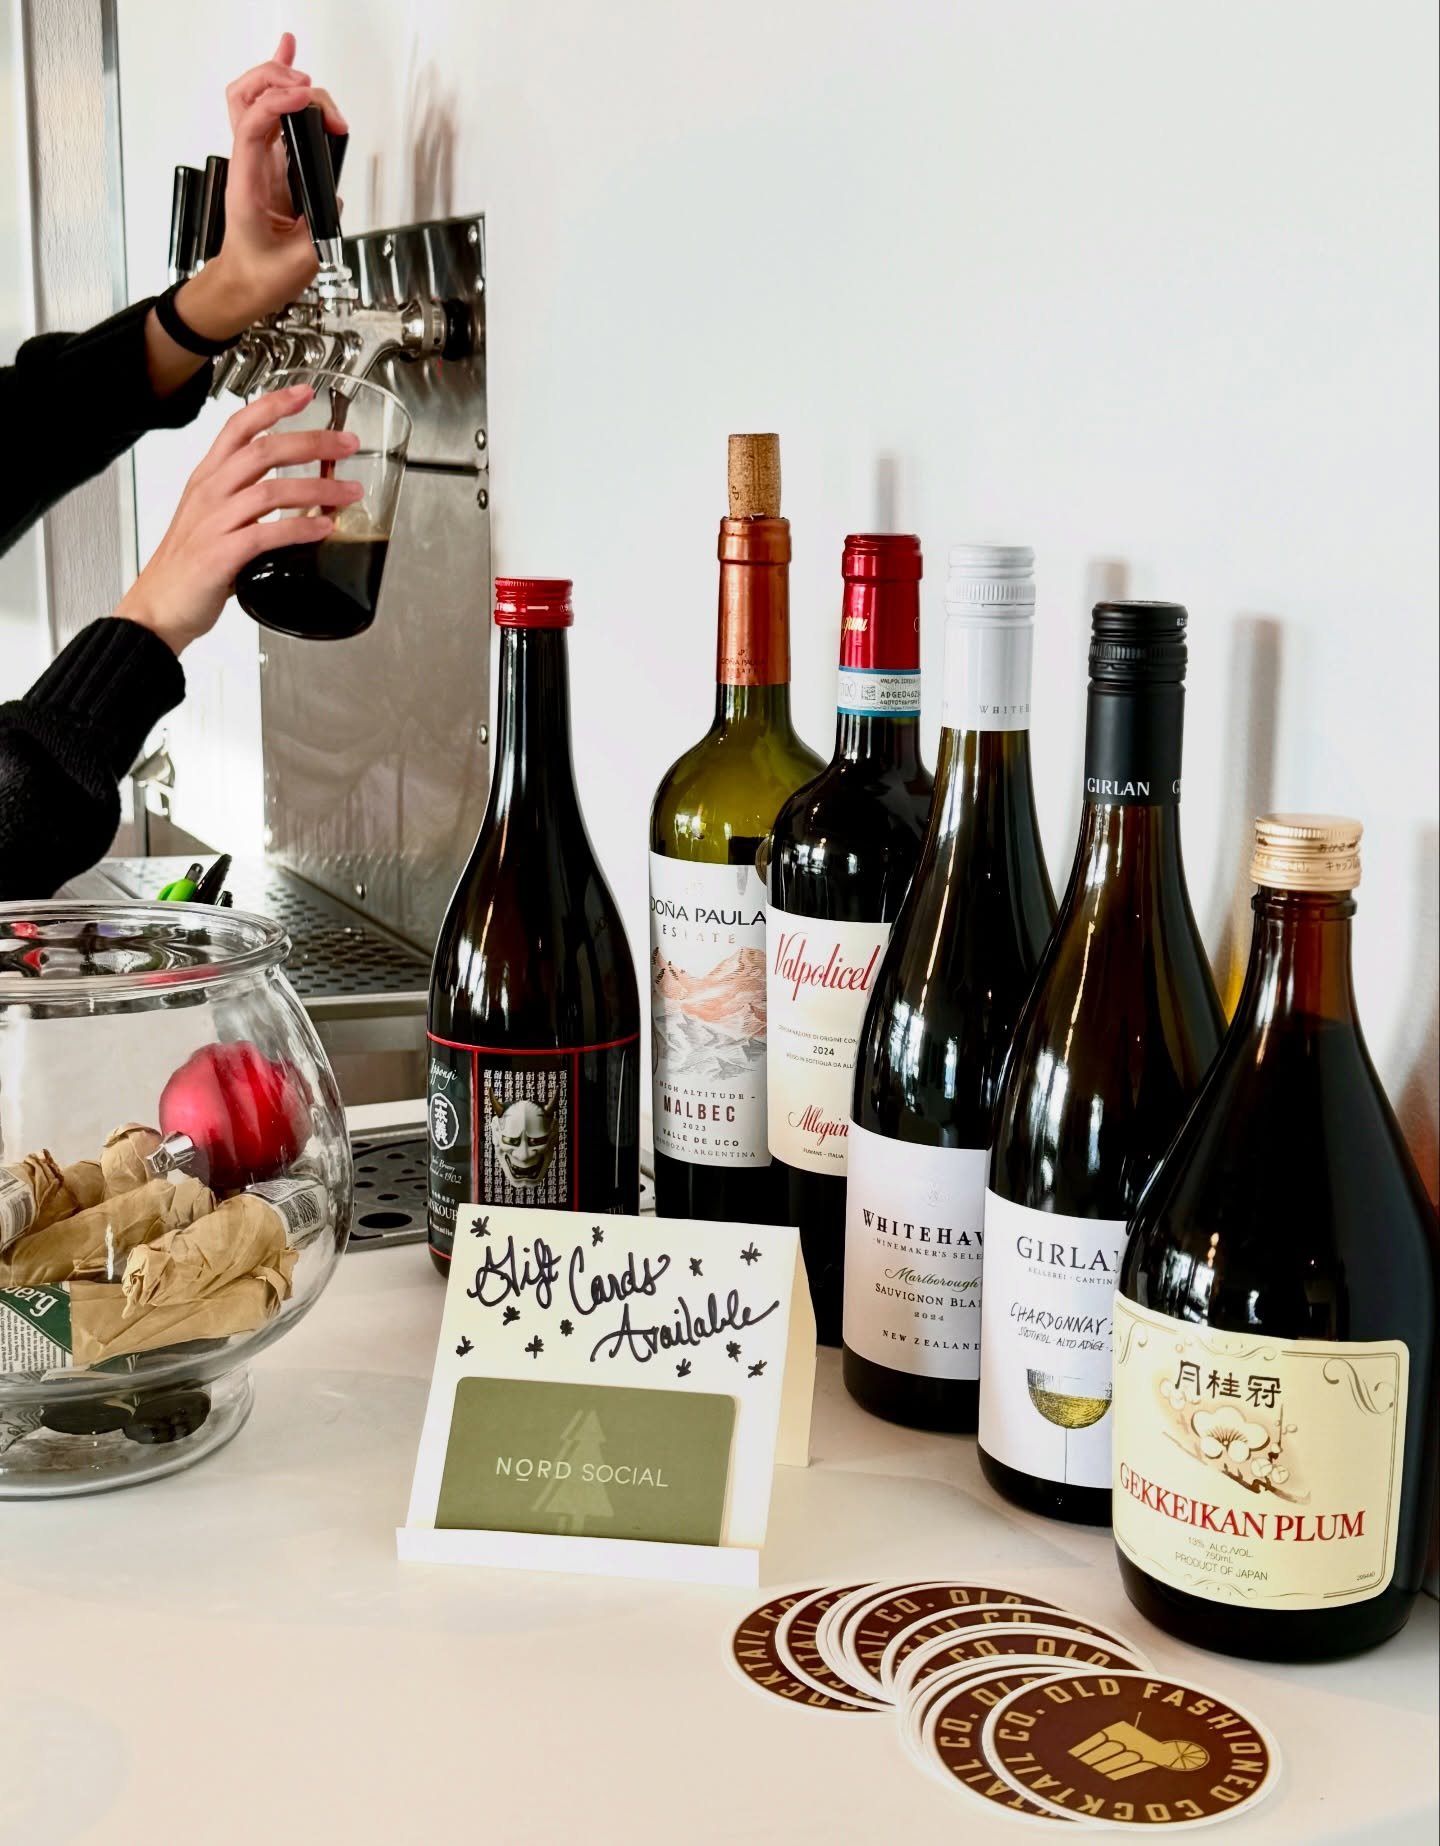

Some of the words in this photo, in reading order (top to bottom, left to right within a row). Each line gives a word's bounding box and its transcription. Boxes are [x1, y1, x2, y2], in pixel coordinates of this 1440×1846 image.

[1087, 778, 1150, 796] GIRLAN
[650, 896, 689, 922] DOÑA
[695, 908, 767, 926] PAULA
[813, 1045, 835, 1056] 2024
[683, 1088, 745, 1100] ALTITUDE
[663, 1095, 735, 1122] MALBEC
[662, 1128, 688, 1141] VALLE
[715, 1139, 740, 1147] UCO
[682, 1122, 707, 1131] 2023
[694, 1149, 756, 1158] ARGENTINA
[875, 1237, 948, 1258] WINEMAKER'S
[467, 1236, 562, 1309] Gift
[569, 1246, 671, 1316] Cards
[884, 1267, 982, 1293] Marlborough
[875, 1283, 944, 1306] SAUVIGNON
[590, 1289, 780, 1363] Available
[914, 1311, 945, 1321] 2024
[1010, 1302, 1107, 1336] CHARDONNAY
[882, 1329, 907, 1342] NEW
[1056, 1337, 1077, 1349] ALTO
[1175, 1360, 1282, 1409] 月桂冠
[495, 1456, 572, 1482] NORD
[582, 1463, 669, 1487] SOCIAL
[1120, 1462, 1268, 1540] GEKKEIKAN
[1273, 1510, 1367, 1542] PLUM
[1175, 1551, 1218, 1573] PRODUCT
[1220, 1566, 1234, 1576] OF
[1235, 1568, 1269, 1582] JAPAN
[1205, 1550, 1234, 1564] 750mL
[1044, 1678, 1122, 1704] OLD
[998, 1707, 1047, 1743] CO.
[1143, 1682, 1265, 1803] FASHIONED
[1005, 1751, 1205, 1823] COCKTAIL
